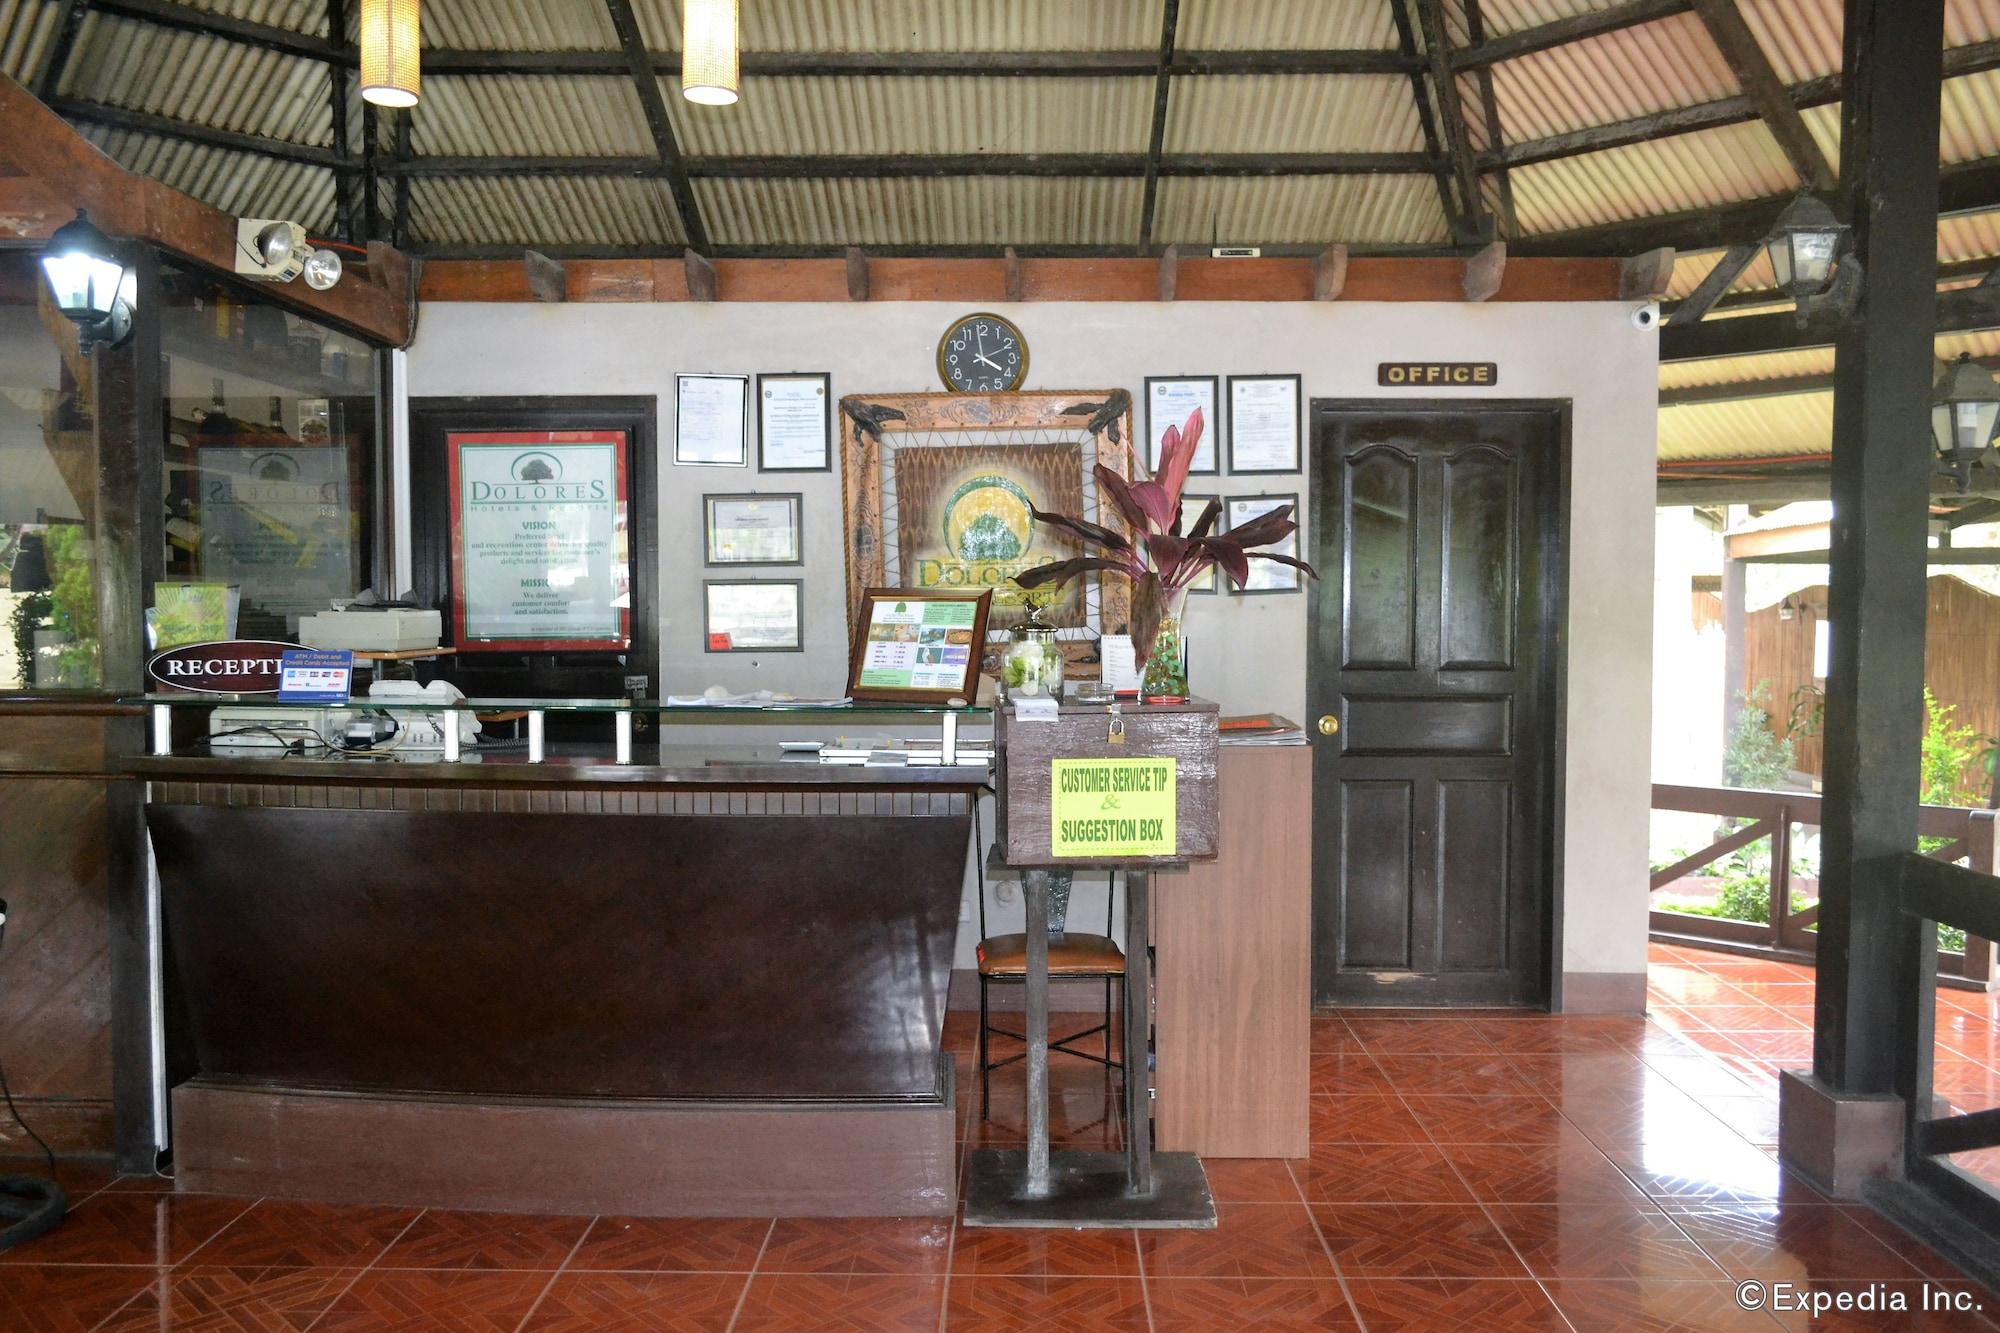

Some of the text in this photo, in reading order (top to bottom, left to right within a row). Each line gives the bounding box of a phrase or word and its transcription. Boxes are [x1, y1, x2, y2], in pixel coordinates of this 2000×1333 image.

[963, 329, 972, 341] 11
[976, 324, 988, 336] 12
[995, 327, 1000, 340] 1
[951, 340, 966, 351] 10
[1003, 337, 1012, 349] 2
[949, 354, 958, 366] 9
[1007, 352, 1017, 364] 3
[953, 367, 962, 380] 8
[1003, 366, 1012, 377] 4
[1387, 366, 1489, 383] OFFICE
[965, 378, 973, 390] 7
[994, 378, 1003, 390] 5
[472, 479, 605, 501] DOLORES
[522, 520, 557, 531] VISION
[917, 555, 1056, 587] DOLOR
[520, 578, 550, 588] MISSI
[166, 659, 283, 676] RECEPTI
[1061, 767, 1168, 793] CUSTOMER SERVICE TIP
[1101, 793, 1121, 811] &
[1061, 818, 1164, 843] SUGGESTION BOX
